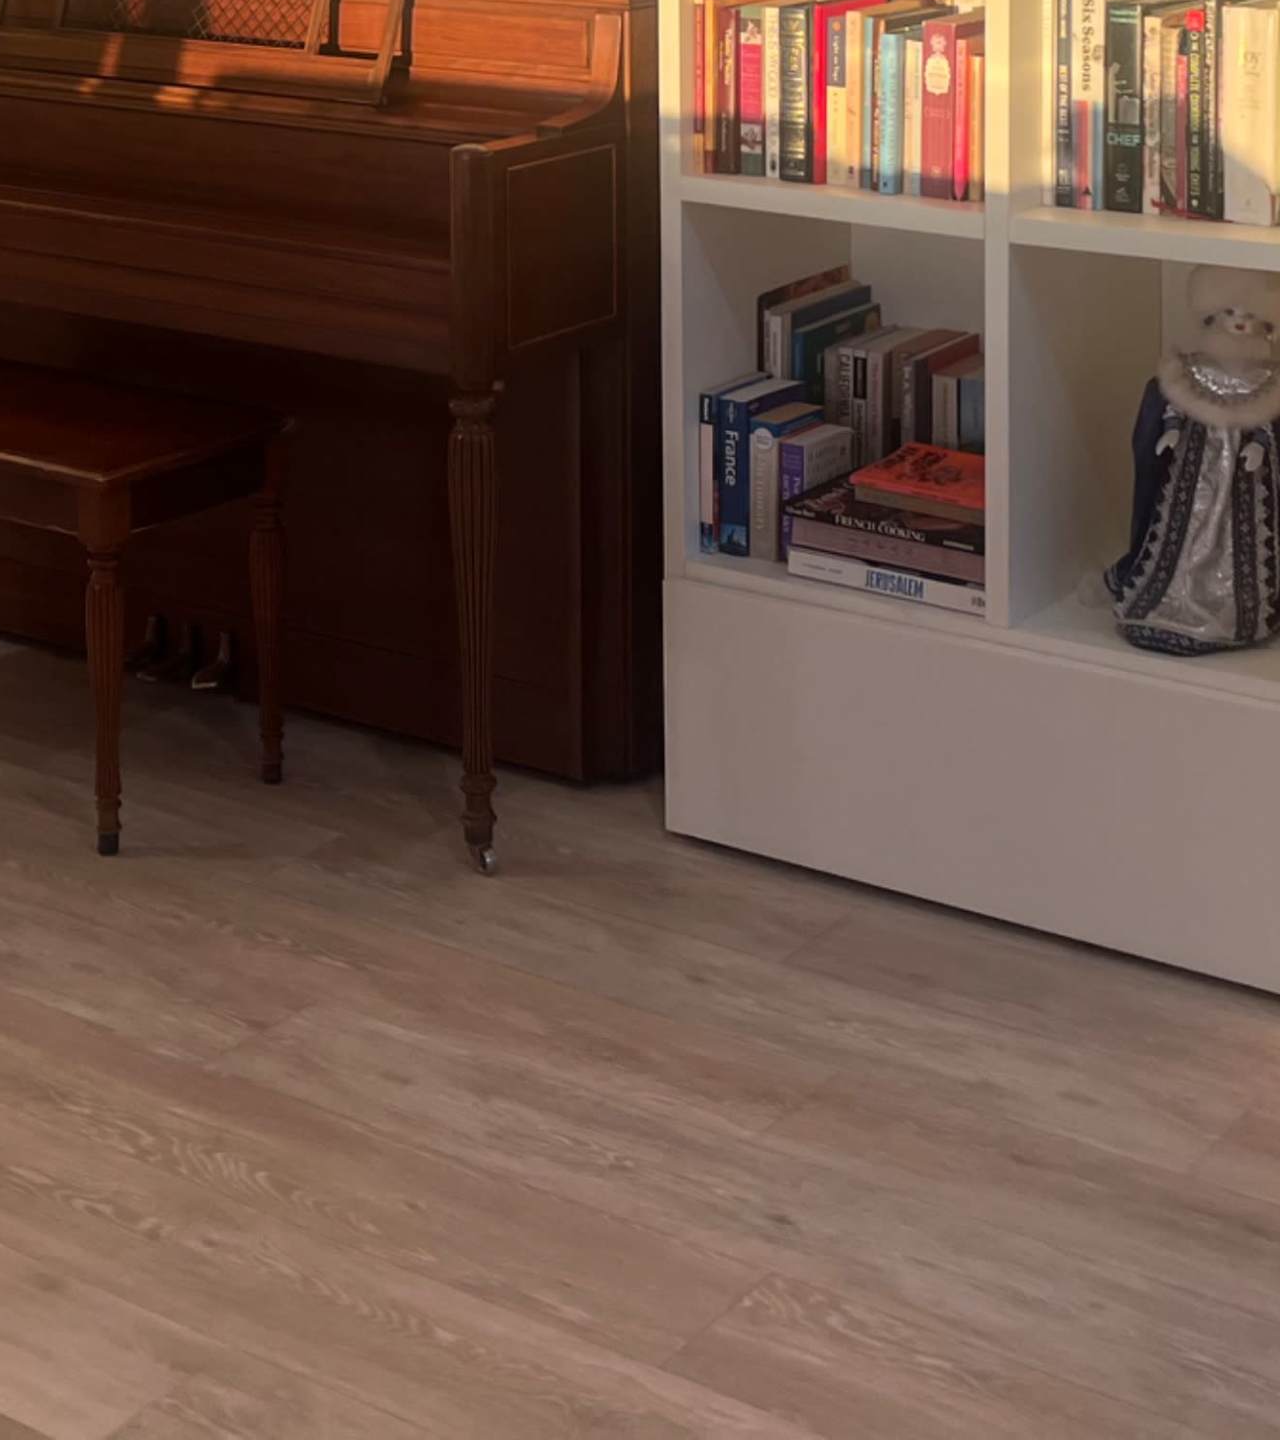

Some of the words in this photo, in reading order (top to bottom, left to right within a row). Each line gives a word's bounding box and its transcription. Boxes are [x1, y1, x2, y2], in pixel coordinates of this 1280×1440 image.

[832, 35, 840, 54] Light
[1082, 27, 1094, 91] Seasons
[1107, 132, 1141, 146] CHEF
[724, 430, 739, 486] France
[877, 520, 926, 542] COOKING
[864, 568, 925, 598] JERUSALEM
